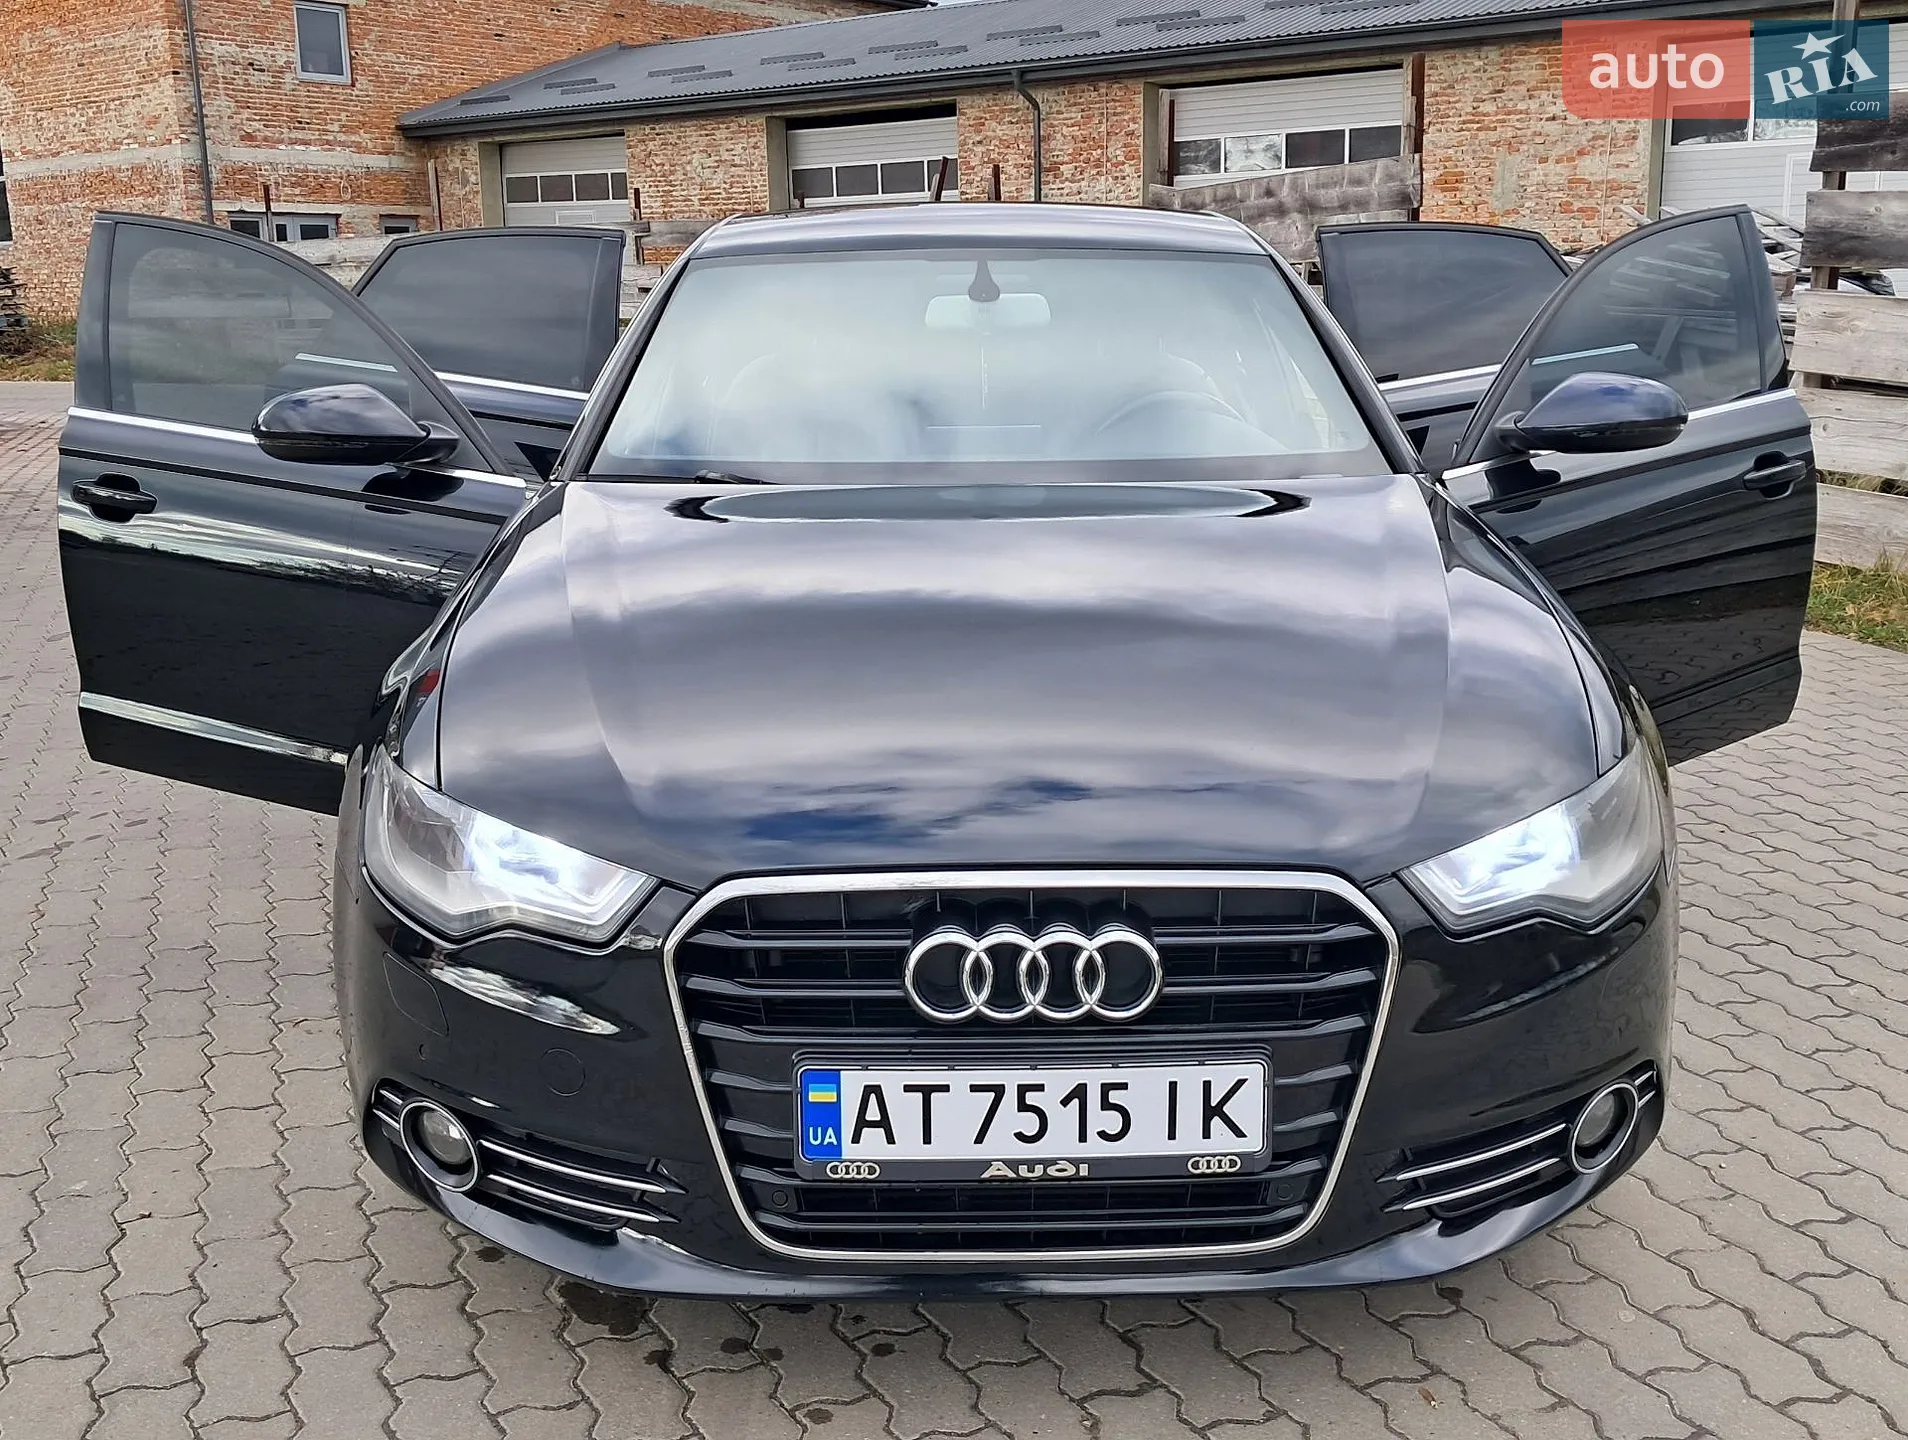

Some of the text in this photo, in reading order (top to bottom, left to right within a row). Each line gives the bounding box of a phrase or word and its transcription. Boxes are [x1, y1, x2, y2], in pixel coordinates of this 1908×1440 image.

[850, 1078, 1248, 1145] AT 7515 IK
[809, 1126, 838, 1146] UA
[980, 1160, 1090, 1180] Audi
